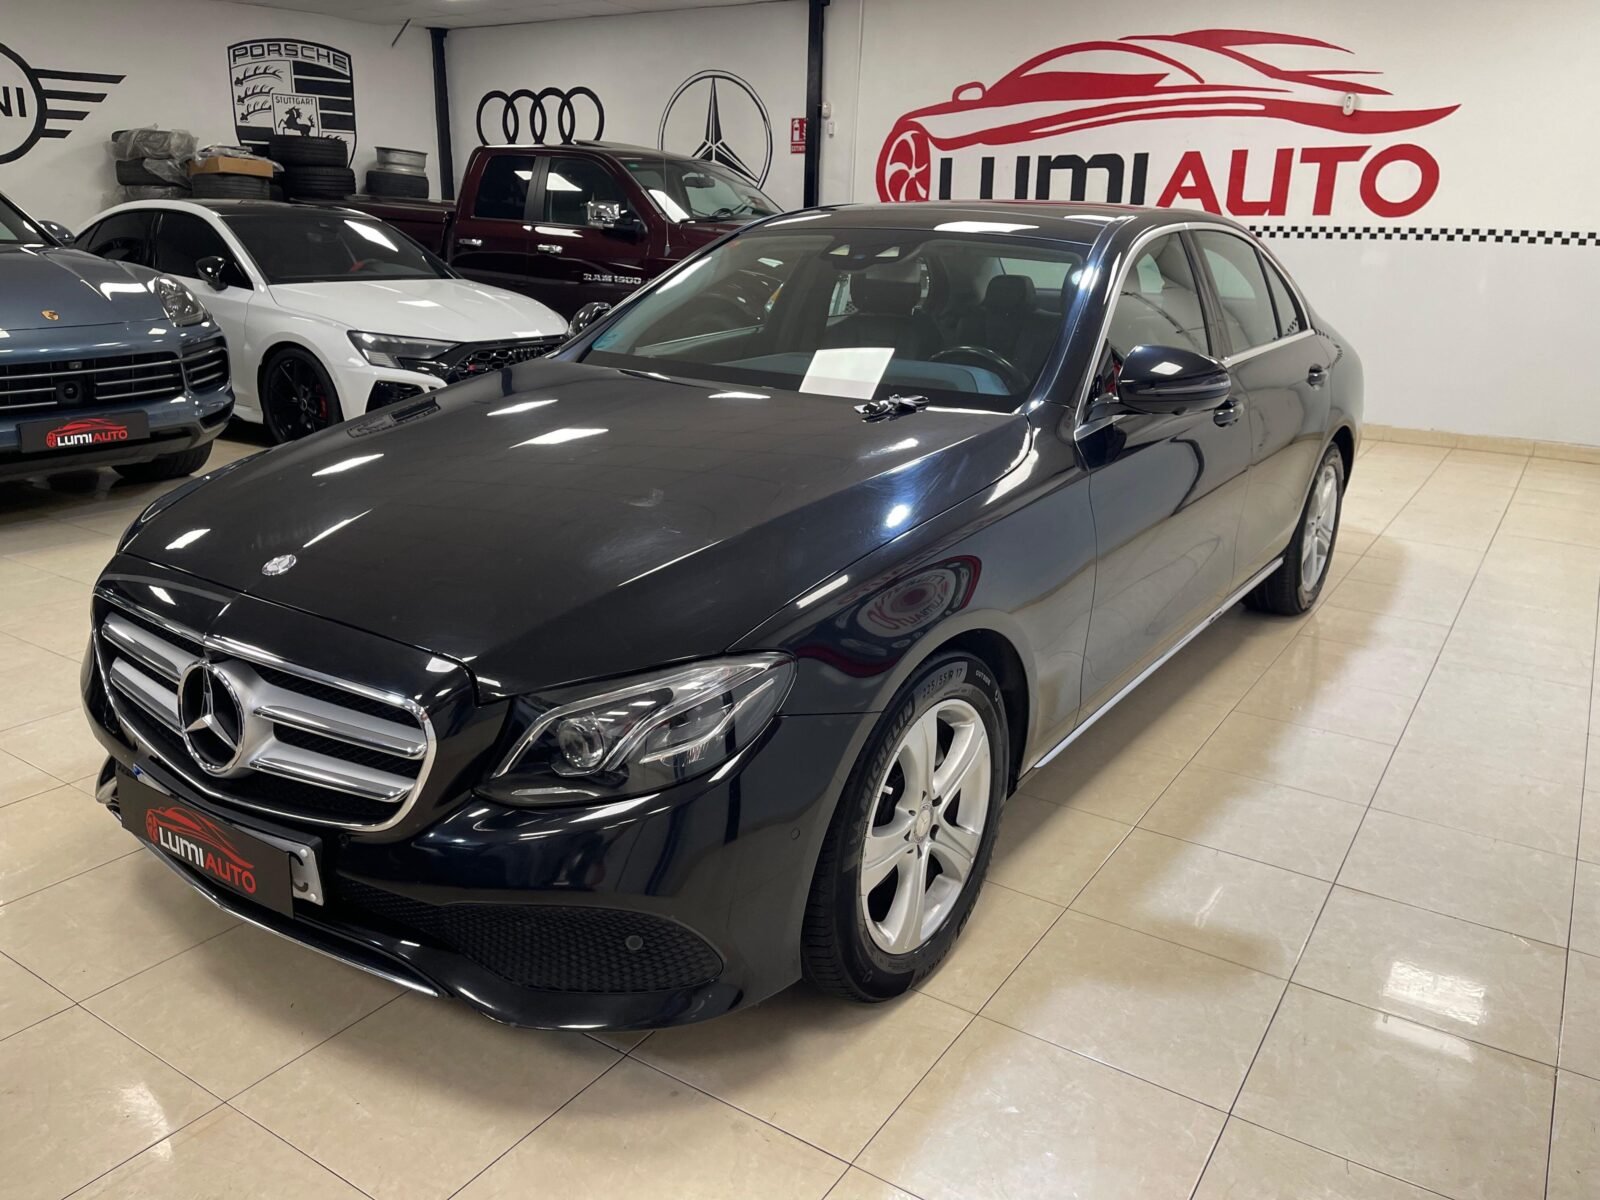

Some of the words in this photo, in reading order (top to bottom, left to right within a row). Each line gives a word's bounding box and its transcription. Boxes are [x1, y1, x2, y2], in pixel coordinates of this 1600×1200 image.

[232, 43, 348, 71] PORSCHE
[275, 95, 314, 105] STUTTGART
[583, 273, 612, 282] RAM
[614, 275, 642, 285] 1500
[860, 699, 914, 811] MICHELIN
